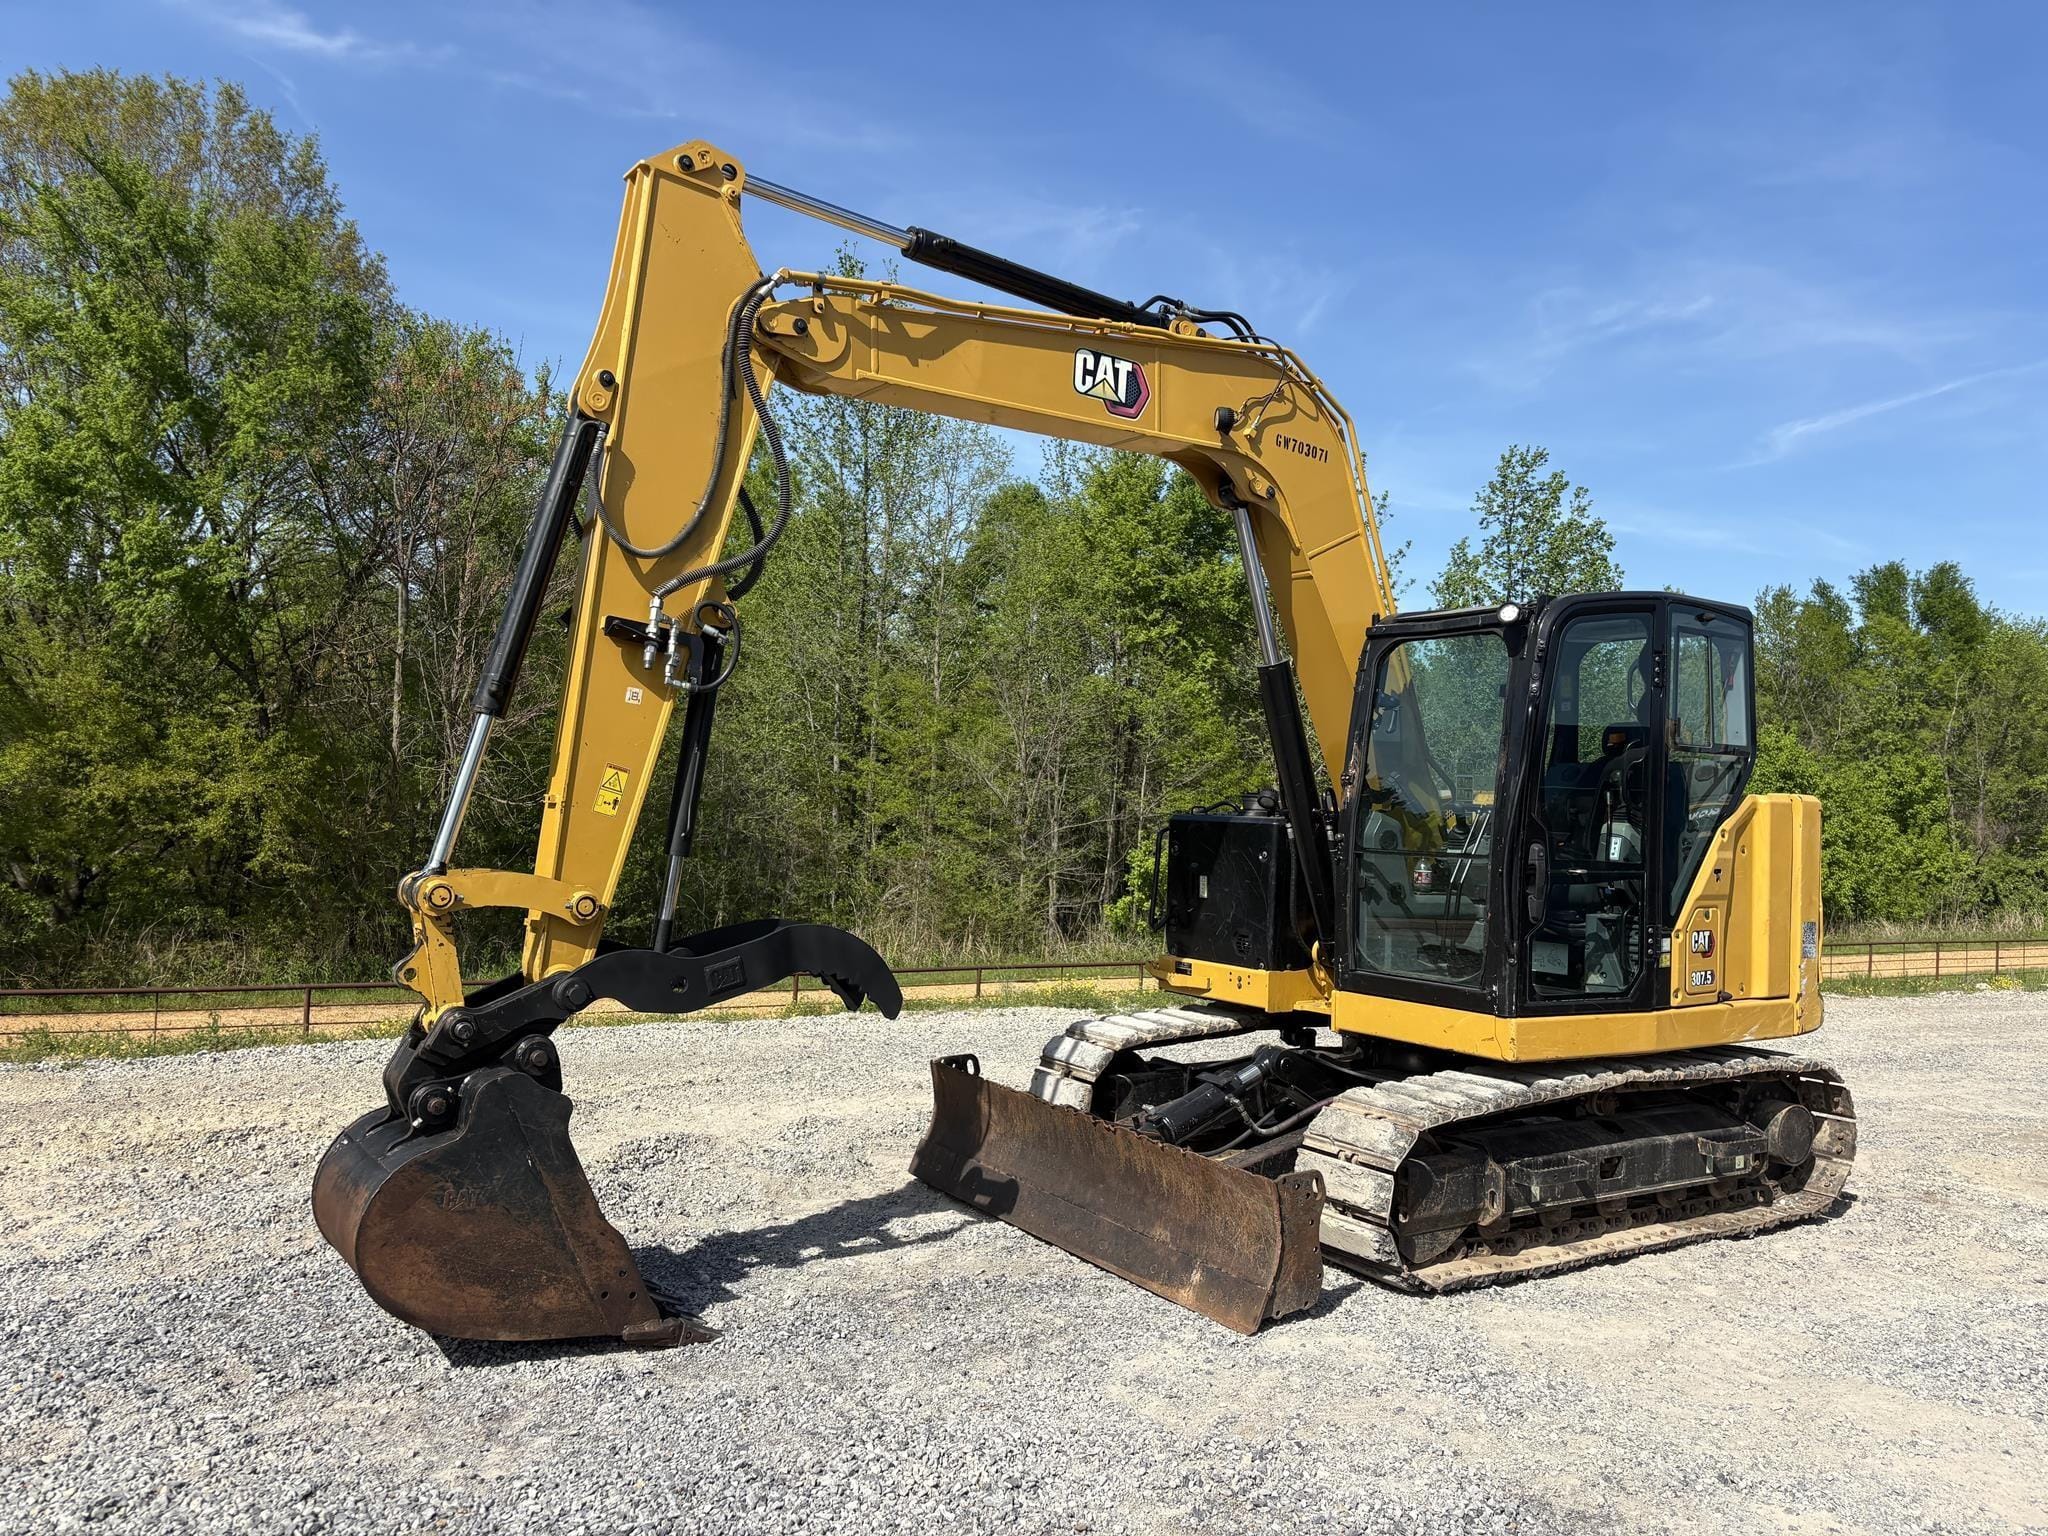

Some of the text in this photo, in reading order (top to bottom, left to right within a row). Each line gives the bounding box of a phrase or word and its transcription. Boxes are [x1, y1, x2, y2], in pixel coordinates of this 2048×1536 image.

[1074, 349, 1133, 403] CAT
[1275, 433, 1329, 463] GW703071
[1691, 931, 1711, 953] CAT
[1691, 971, 1712, 986] 307.5
